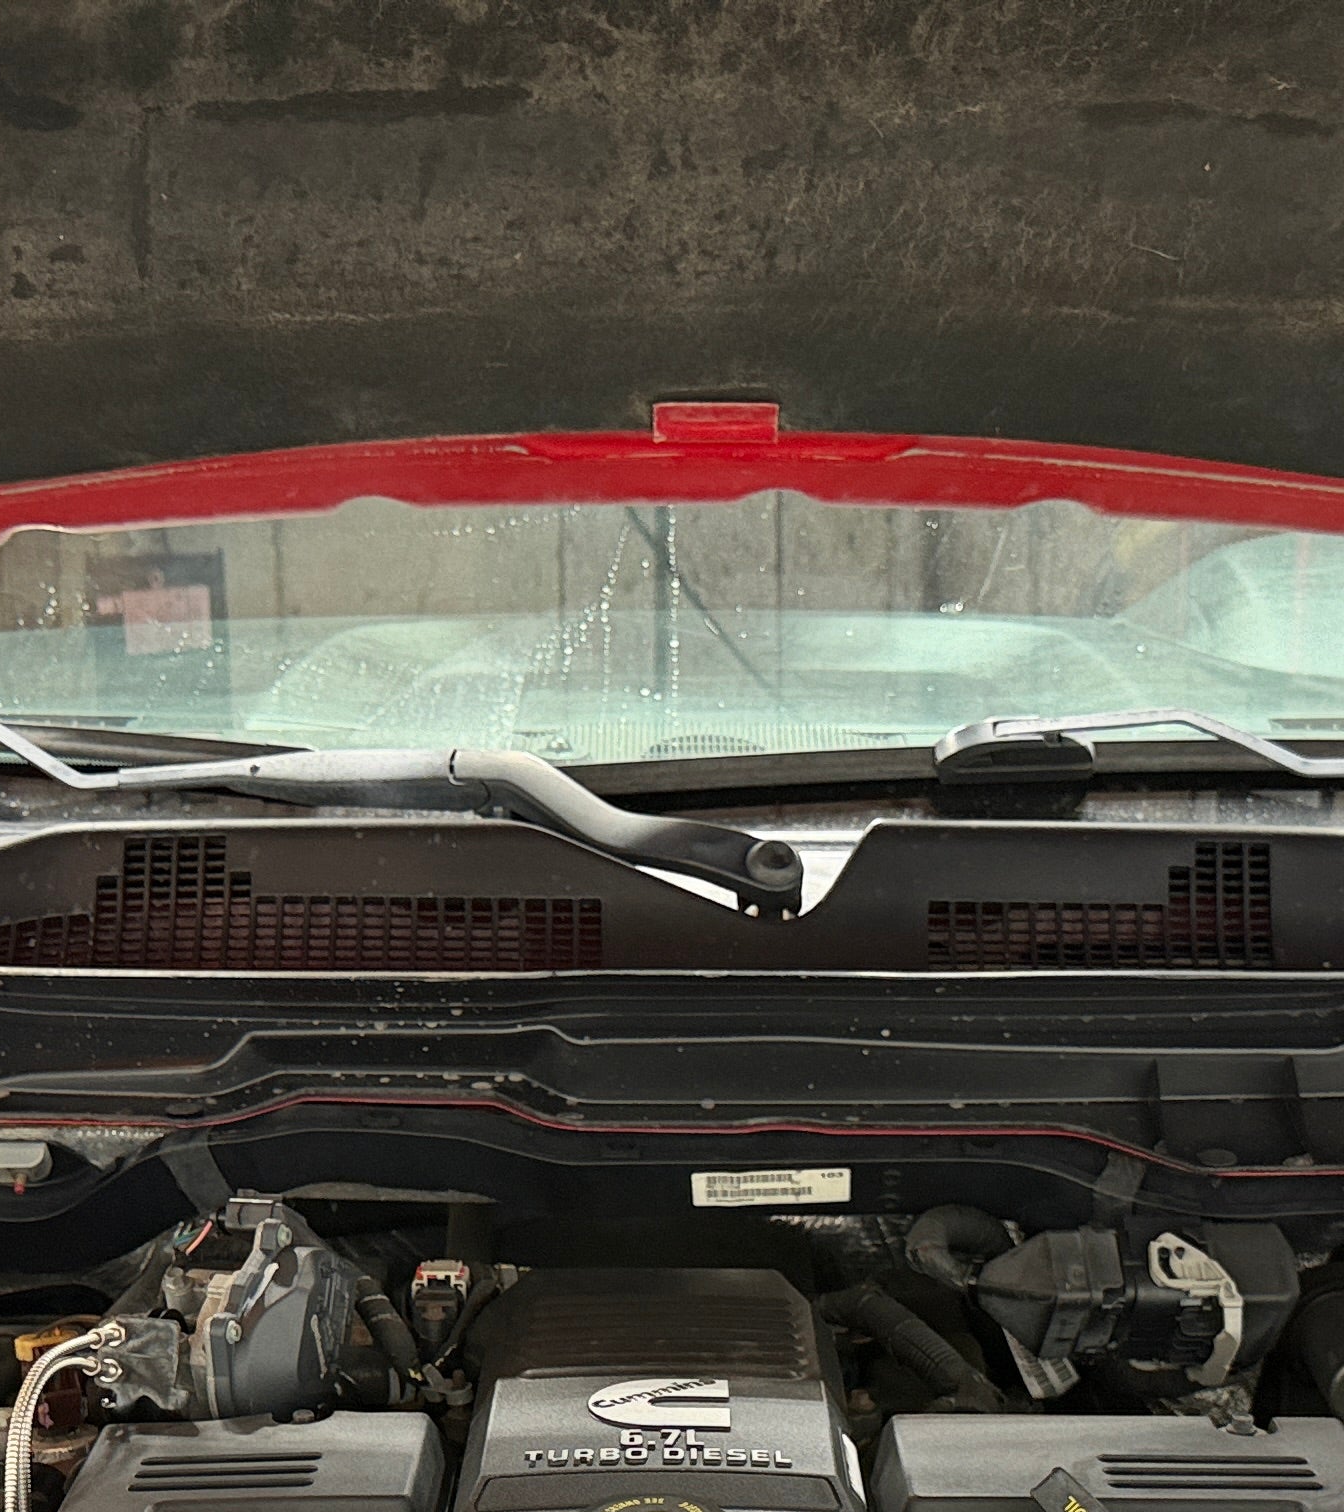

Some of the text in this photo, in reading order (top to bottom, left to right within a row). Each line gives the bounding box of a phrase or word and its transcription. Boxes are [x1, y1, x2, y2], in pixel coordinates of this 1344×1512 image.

[619, 1429, 705, 1449] 6.7L
[524, 1448, 793, 1467] TURBO DIESEL
